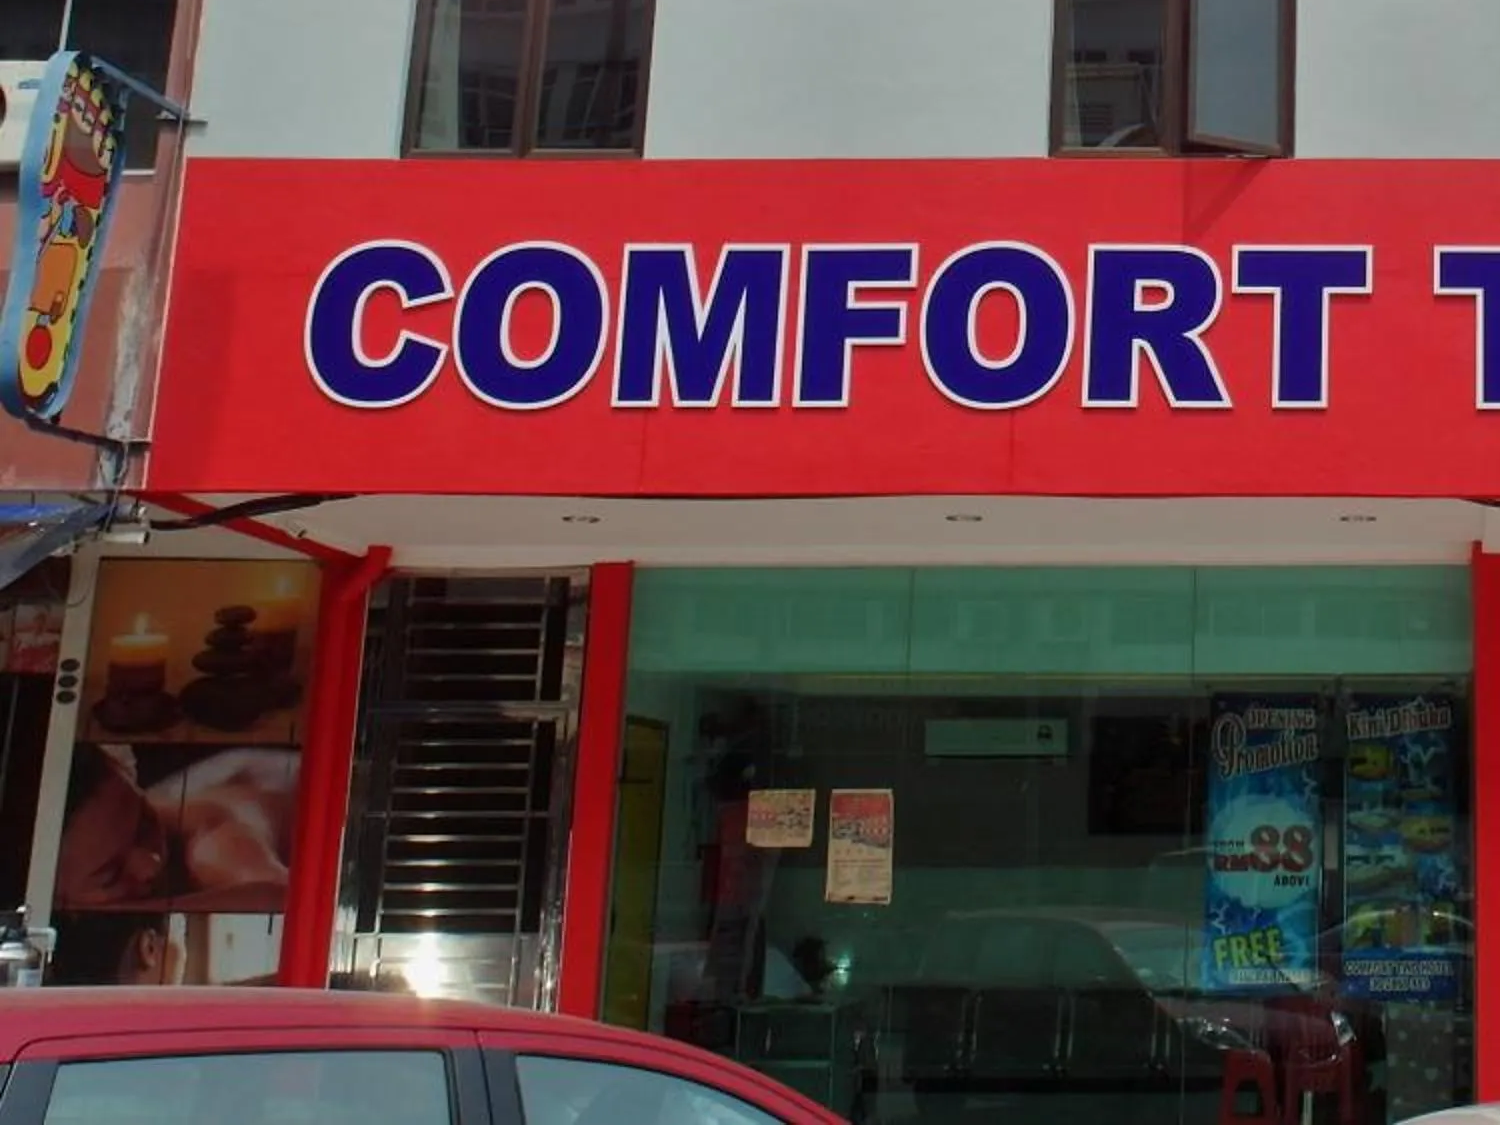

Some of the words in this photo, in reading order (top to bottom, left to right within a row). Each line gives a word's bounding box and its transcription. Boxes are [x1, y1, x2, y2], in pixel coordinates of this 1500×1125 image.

[305, 240, 1373, 410] COMFORT
[1211, 713, 1319, 777] Promotion
[1247, 708, 1316, 730] OPENING
[1212, 928, 1284, 971] FREE
